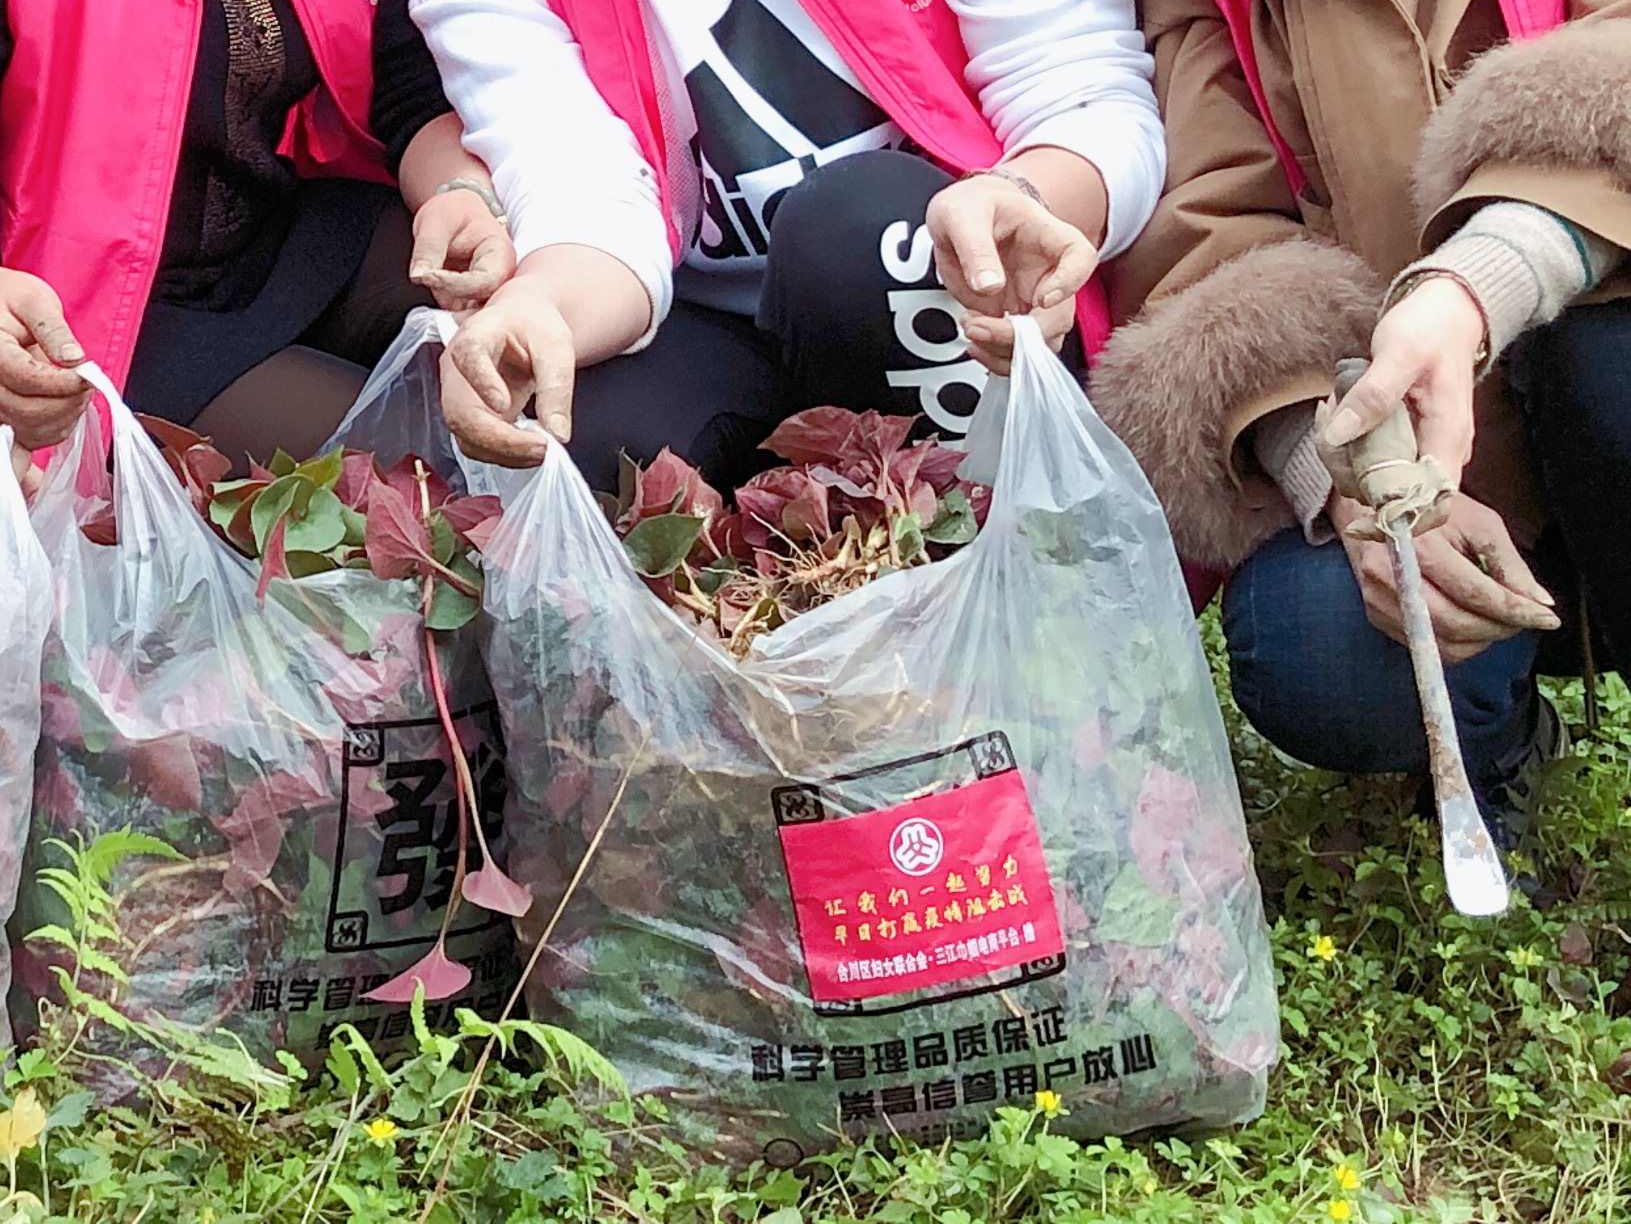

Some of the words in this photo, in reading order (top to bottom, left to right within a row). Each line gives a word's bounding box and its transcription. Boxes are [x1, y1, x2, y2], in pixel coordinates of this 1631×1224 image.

[824, 853, 1019, 917] 让我们一起努力
[833, 884, 1030, 946] 早日打赢疫情阻击战
[750, 1006, 1068, 1082] 科学管理品质保证
[839, 1034, 1157, 1122] 崇高信誉用户放心
